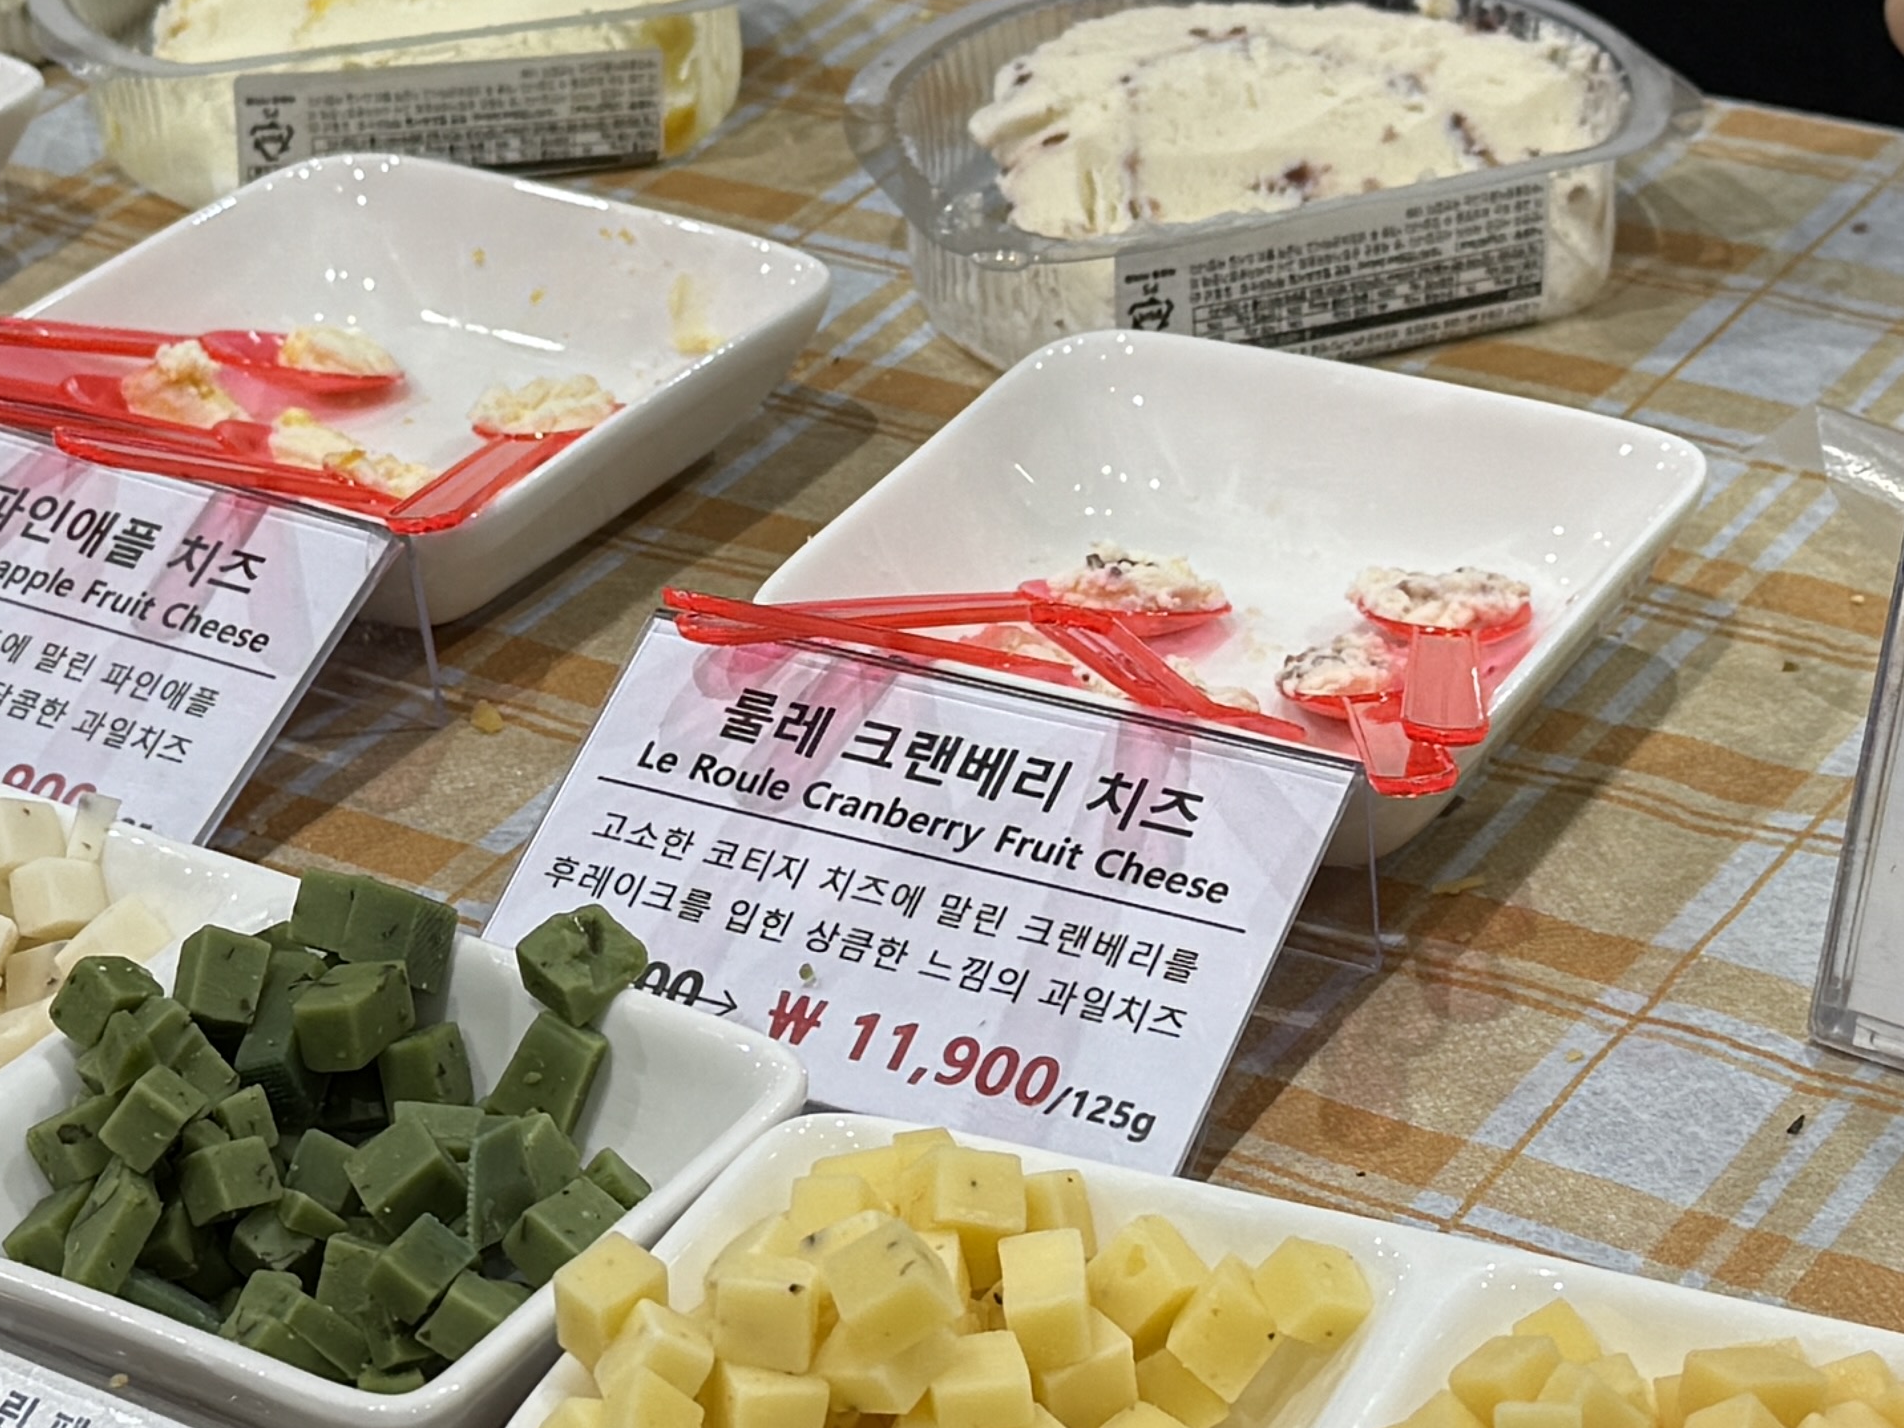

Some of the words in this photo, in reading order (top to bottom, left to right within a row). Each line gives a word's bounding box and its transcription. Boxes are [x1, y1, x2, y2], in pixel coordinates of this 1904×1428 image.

[79, 577, 157, 622] Fruit
[160, 601, 271, 654] Cheese
[164, 526, 267, 595] 치즈
[635, 739, 679, 774] Le
[687, 751, 791, 802] Roule
[801, 779, 986, 853] Cranberry
[992, 823, 1084, 871] Fruit
[1093, 847, 1230, 904] Cheese
[718, 700, 837, 759] 룰레
[839, 719, 1074, 814] 크랜베리
[1084, 770, 1204, 838] 치즈
[590, 810, 696, 862] 고소한
[700, 838, 810, 891] 코티지
[817, 864, 927, 919] 치즈에
[935, 892, 1009, 938] 말린
[1015, 914, 1199, 984] 크랜베리를
[848, 1010, 1157, 1145] 11,900/125g
